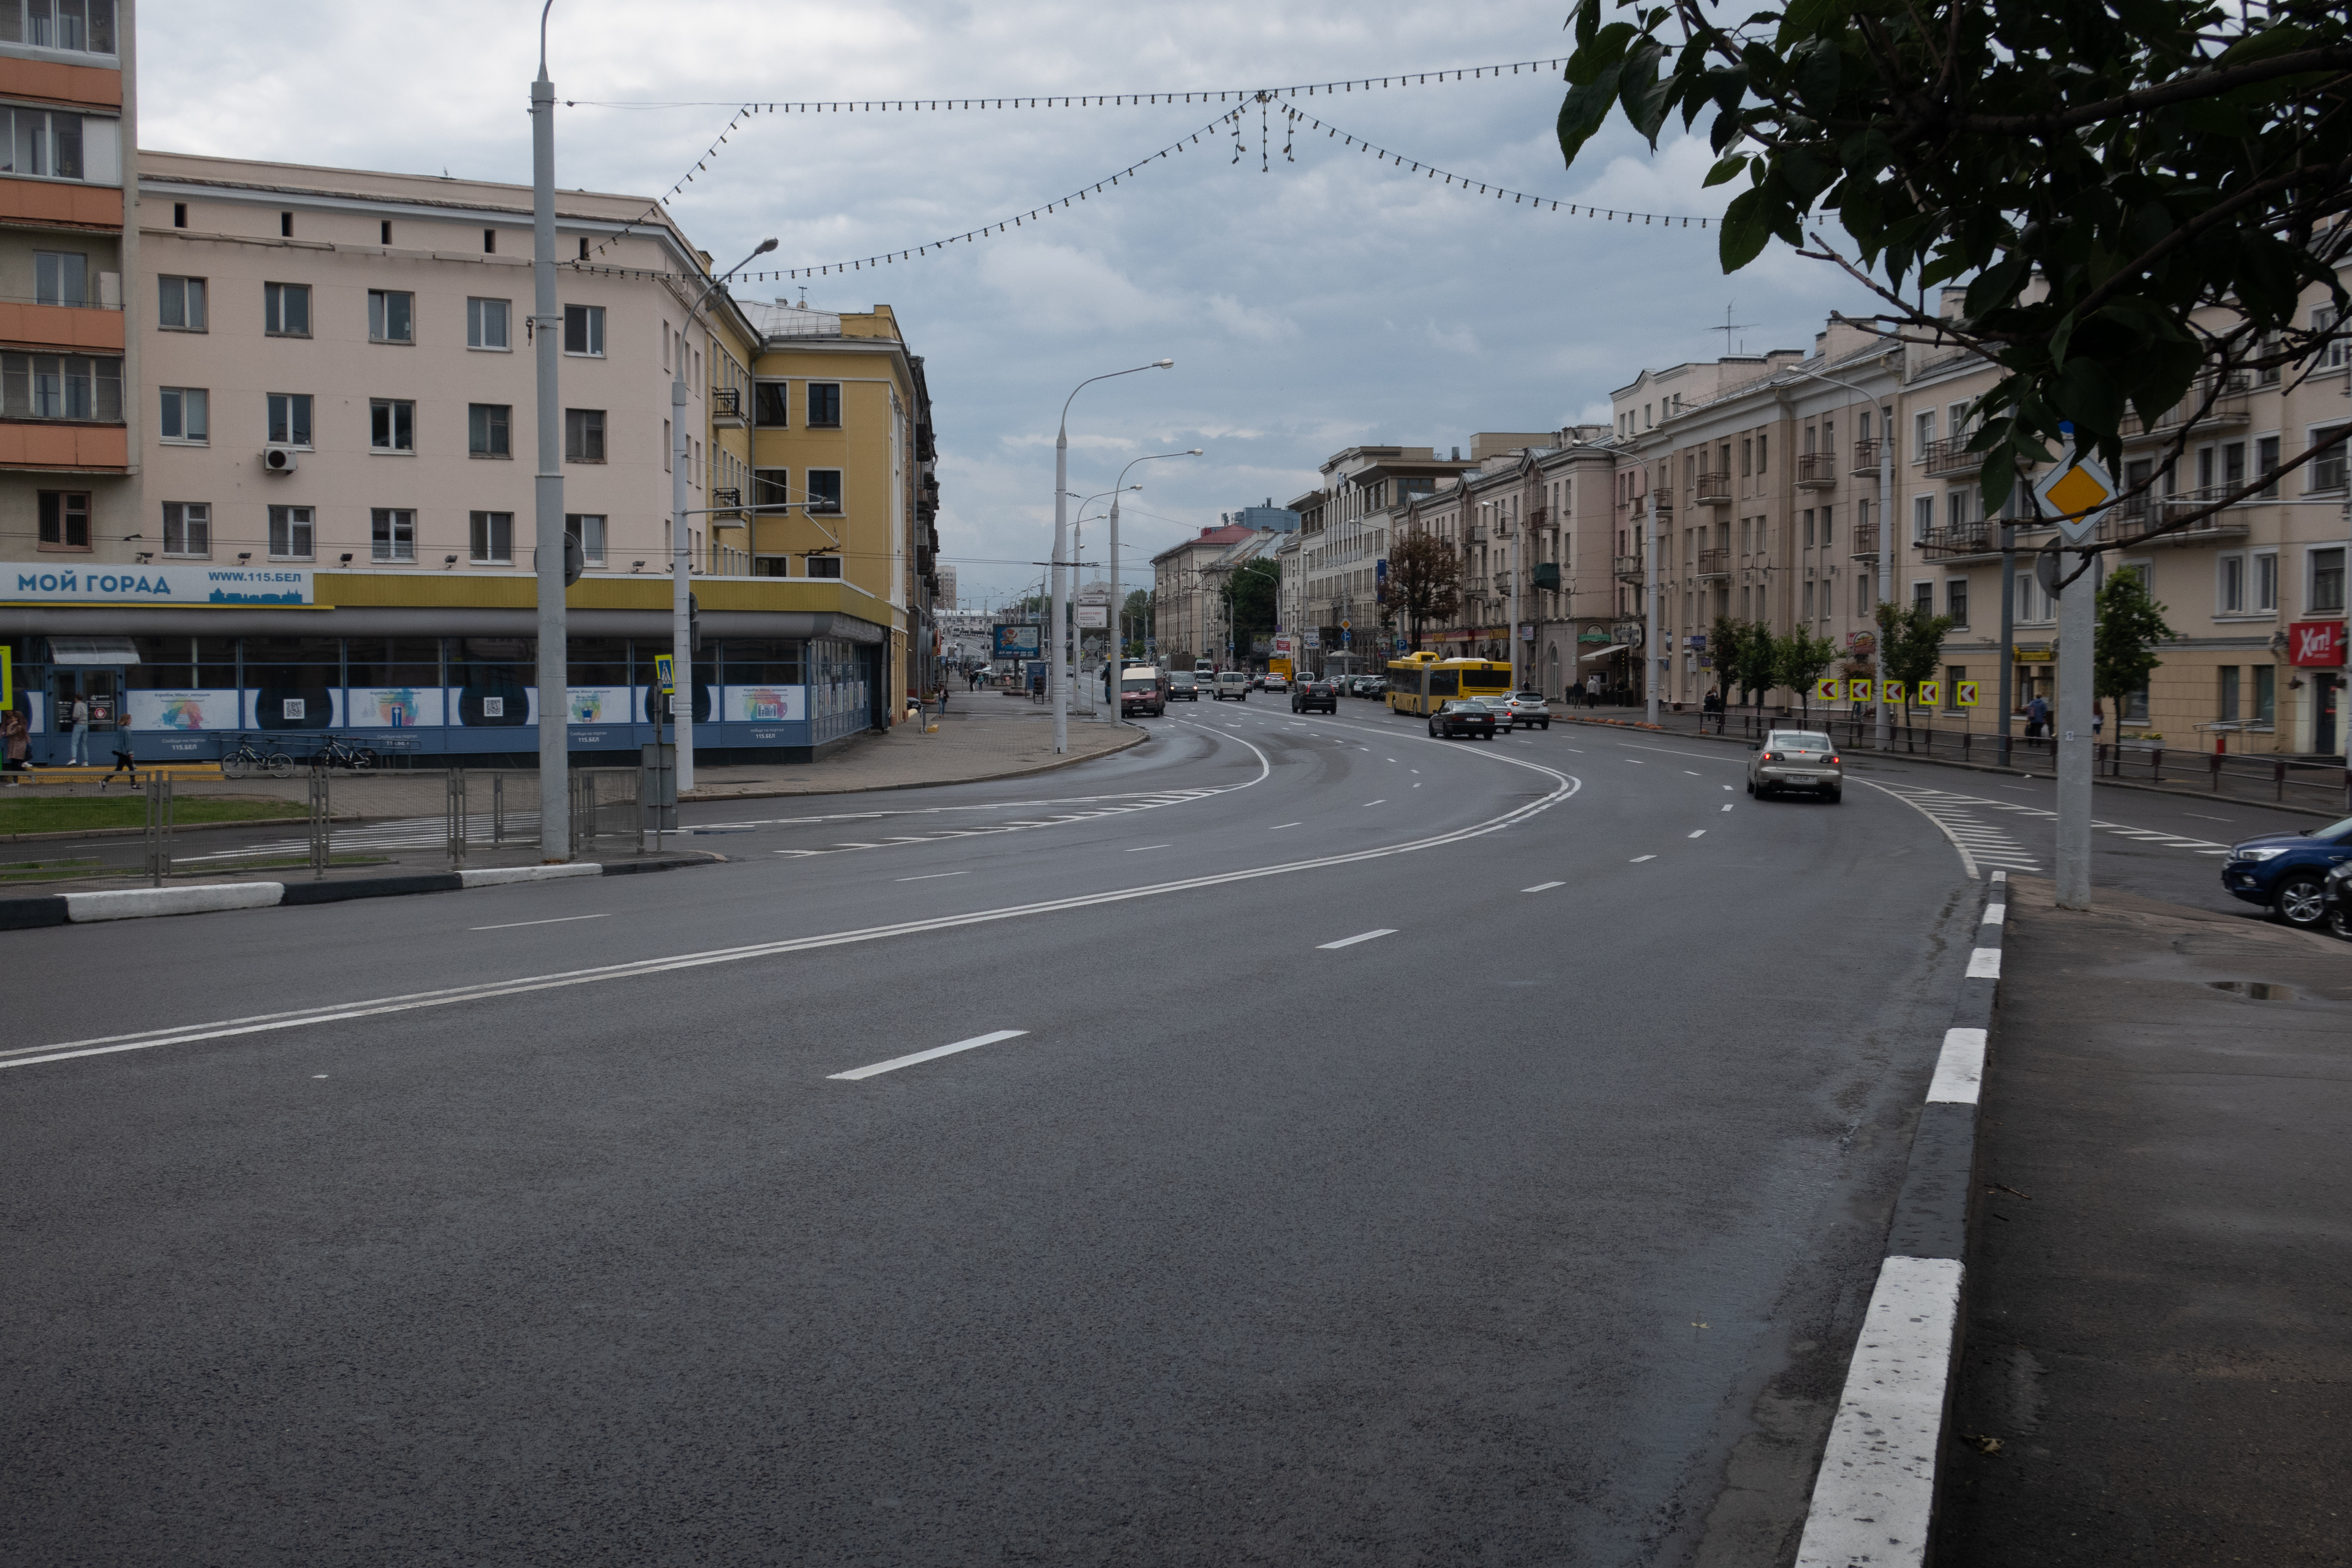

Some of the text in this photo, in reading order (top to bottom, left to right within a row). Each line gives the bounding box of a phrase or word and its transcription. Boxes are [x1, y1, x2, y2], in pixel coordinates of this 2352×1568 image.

[18, 570, 171, 594] МОЙ ГОРАД
[208, 572, 301, 582] WWW.115.БЕЛ
[1399, 640, 1405, 649] P
